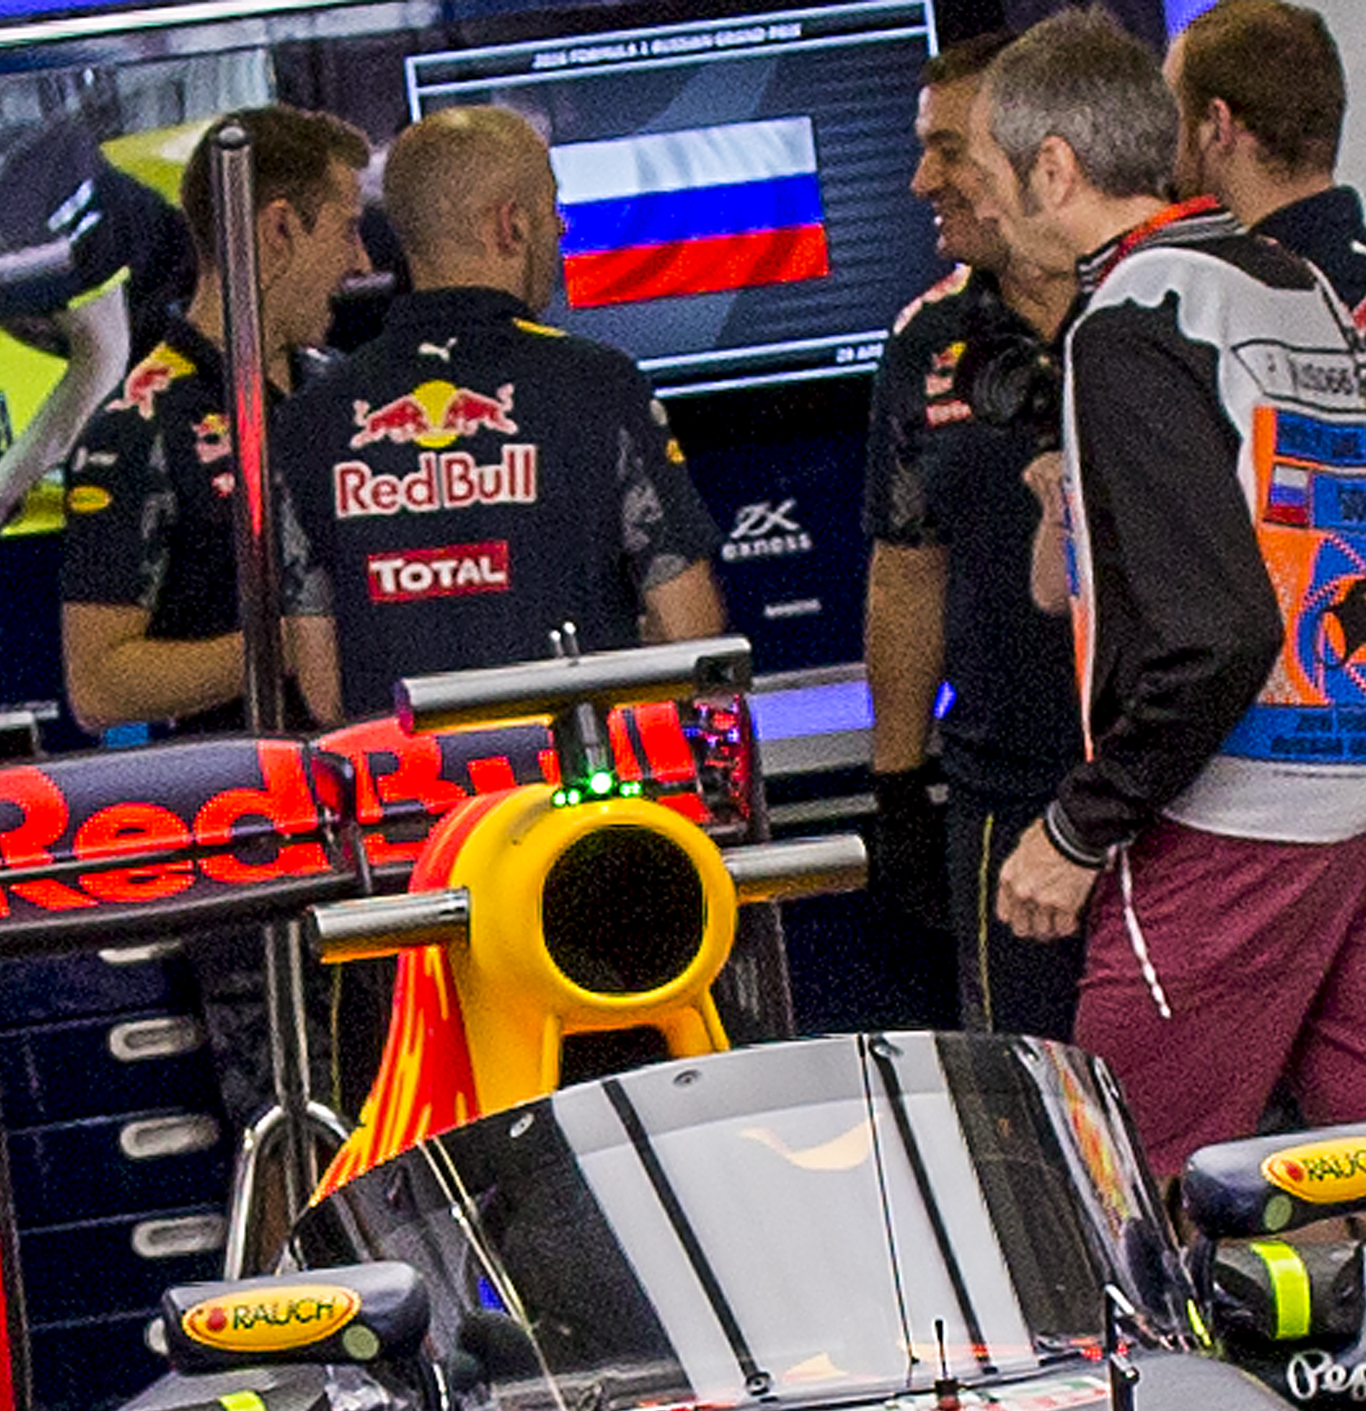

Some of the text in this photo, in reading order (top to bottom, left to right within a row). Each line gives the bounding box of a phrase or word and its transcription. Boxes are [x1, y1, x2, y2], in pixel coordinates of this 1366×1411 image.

[334, 443, 537, 518] Red Bull
[369, 551, 508, 596] TOTAL
[232, 1298, 335, 1331] RAUCH
